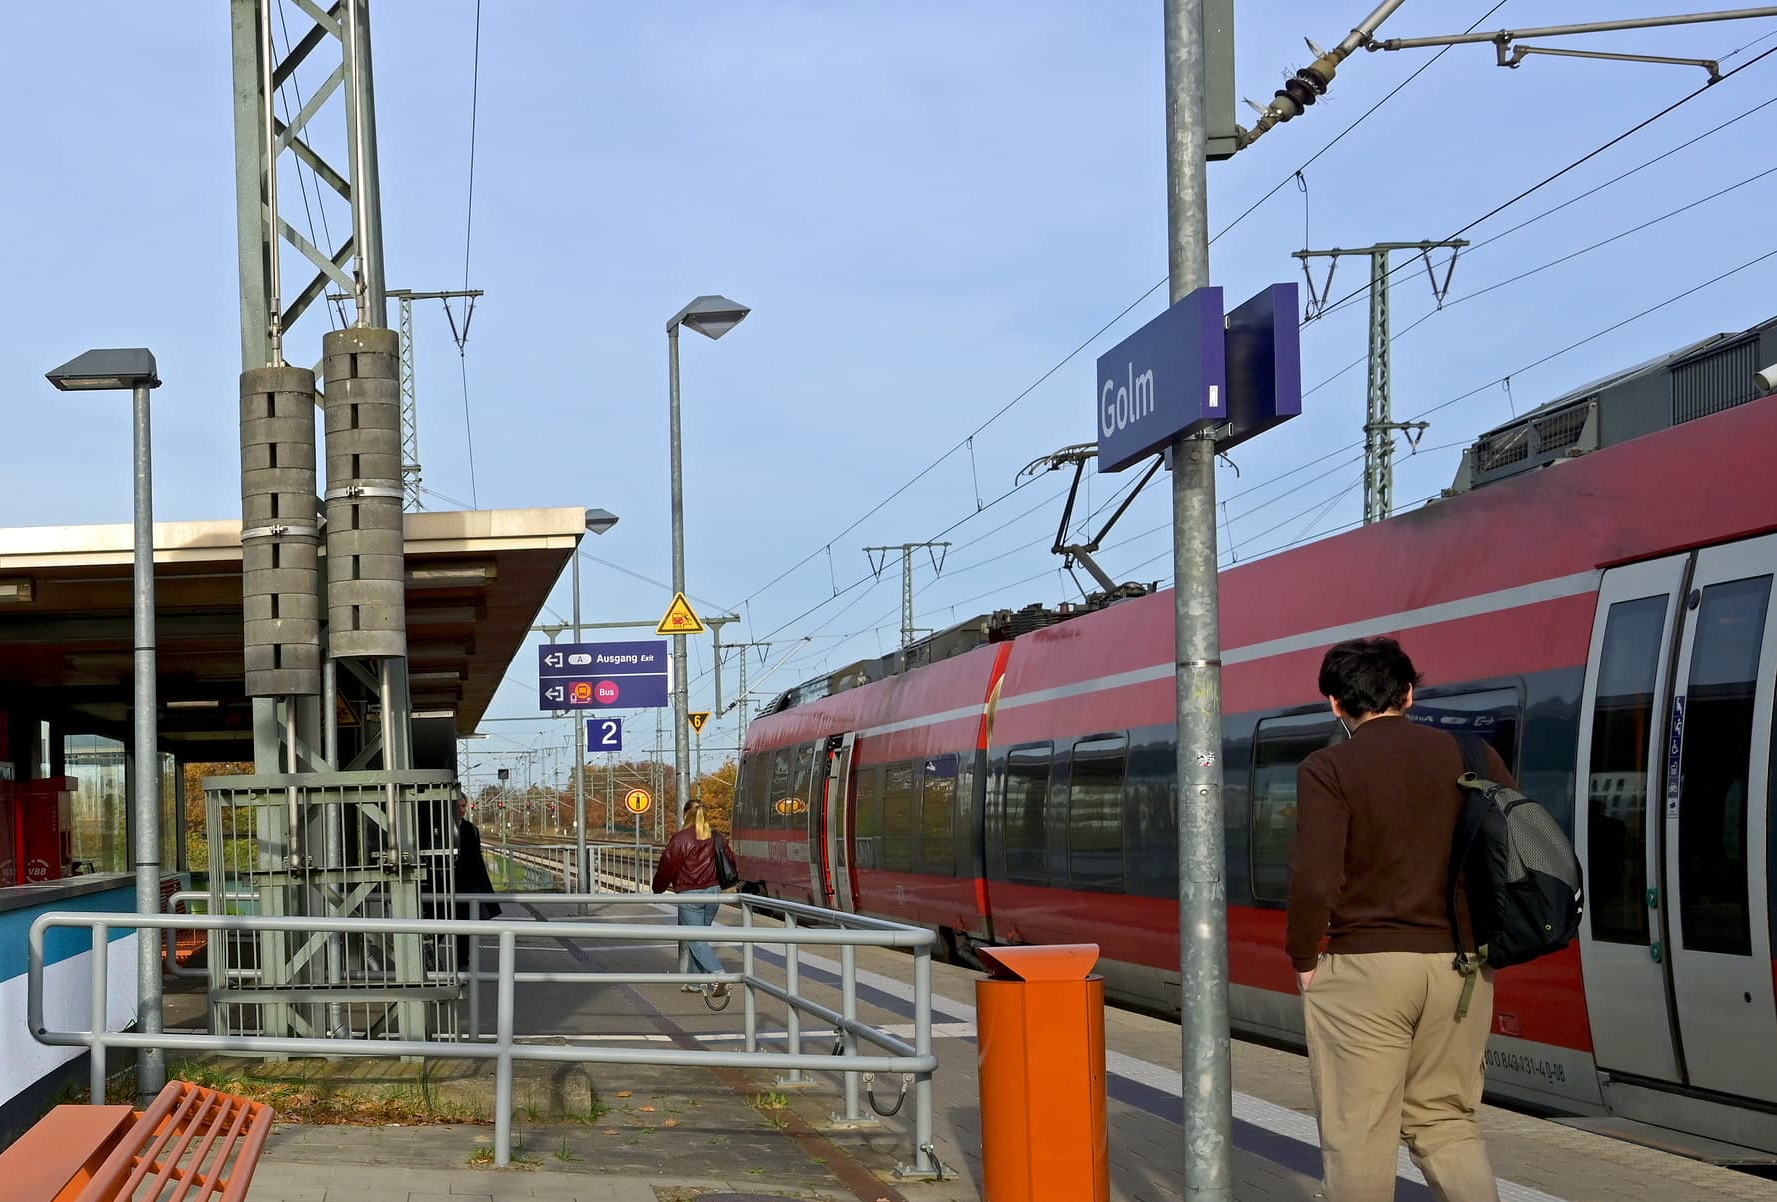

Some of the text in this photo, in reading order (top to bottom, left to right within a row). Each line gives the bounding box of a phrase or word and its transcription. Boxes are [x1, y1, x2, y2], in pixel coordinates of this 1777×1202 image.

[1101, 361, 1155, 438] Golm
[597, 654, 638, 664] Ausgang
[599, 688, 615, 696] Bus
[694, 715, 701, 728] 6
[601, 721, 618, 745] 2
[28, 867, 47, 876] VBB
